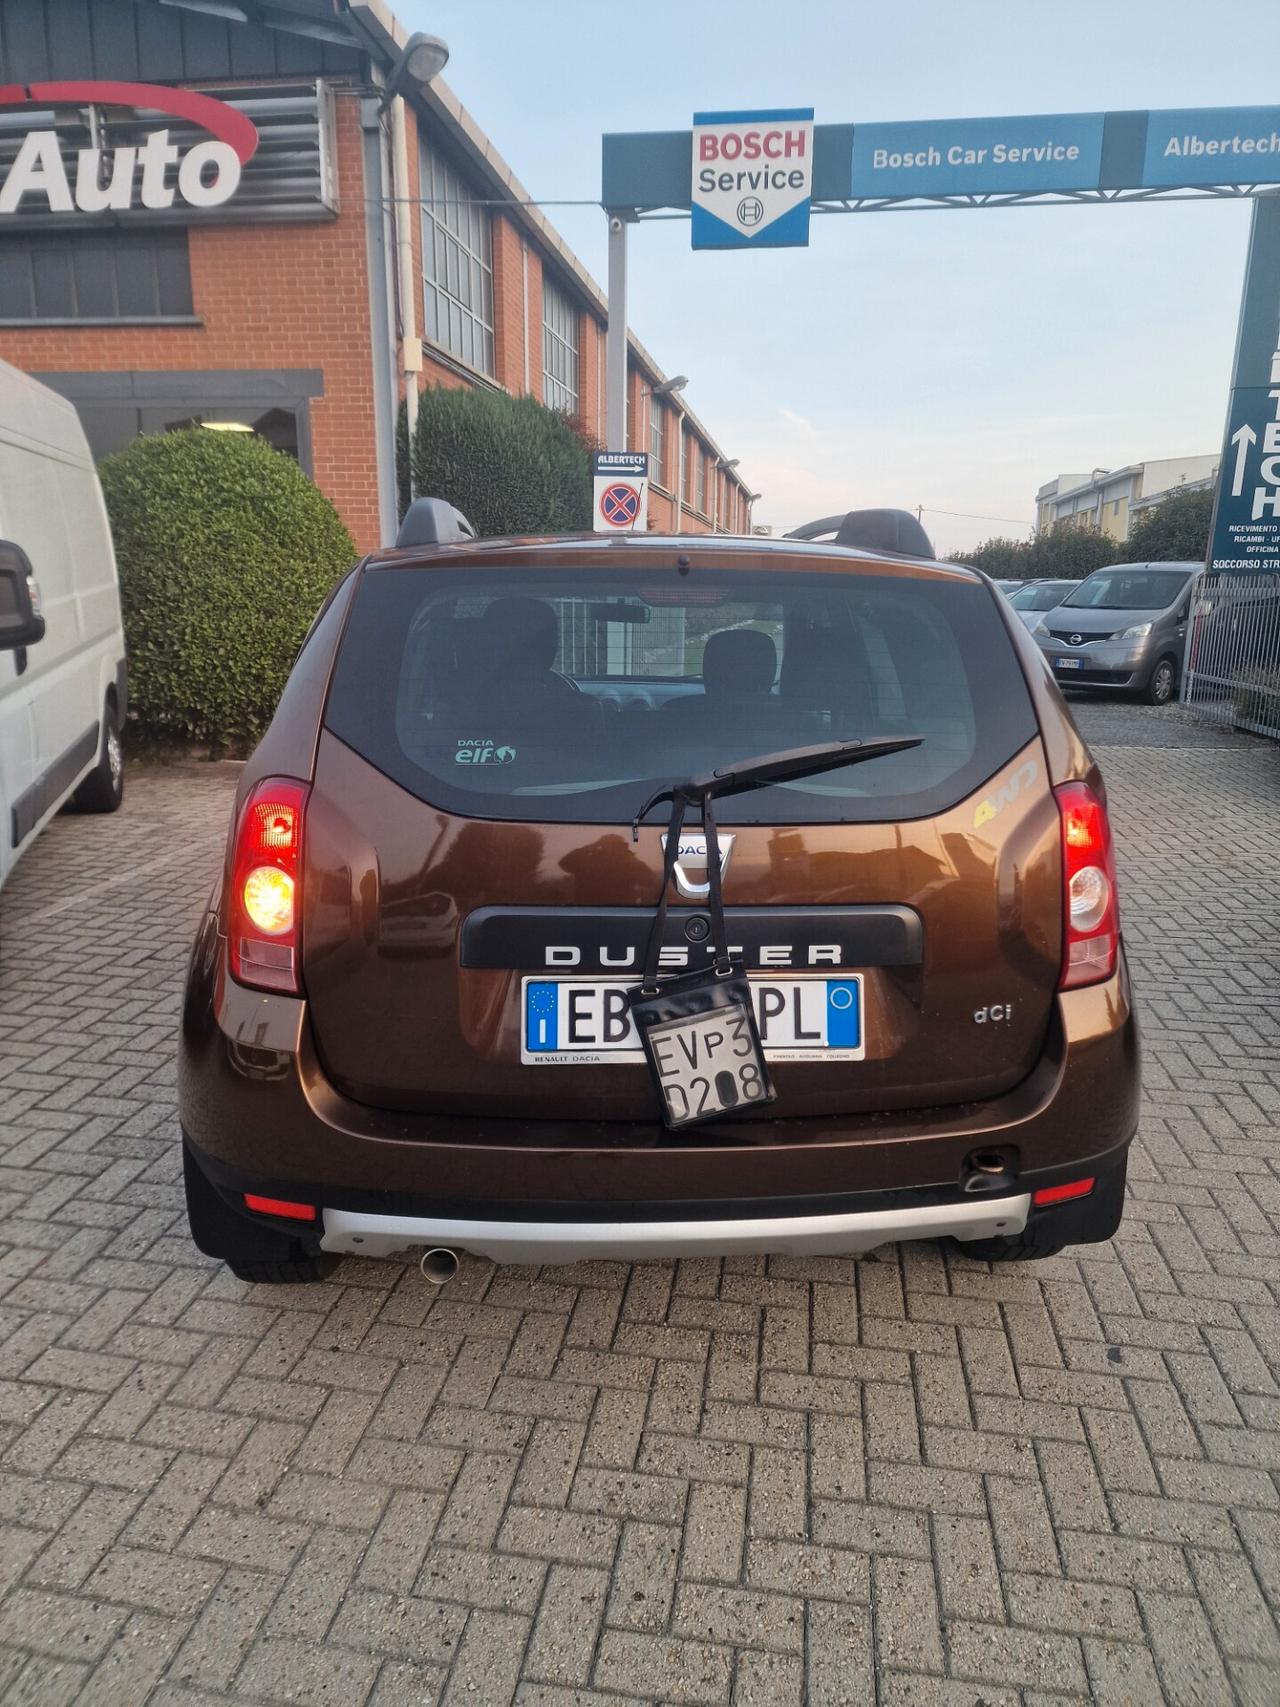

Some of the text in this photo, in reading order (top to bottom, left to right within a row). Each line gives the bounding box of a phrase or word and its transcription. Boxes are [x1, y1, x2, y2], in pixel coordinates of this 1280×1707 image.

[699, 130, 806, 161] BOSCH
[873, 141, 1080, 169] Bosch Car Service
[1164, 132, 1280, 157] Albertech
[0, 129, 242, 213] Auto
[699, 163, 805, 192] Service
[598, 455, 646, 464] ALBERTECH
[1212, 559, 1260, 569] SOCCORSO
[455, 747, 494, 763] elf
[973, 760, 1038, 829] 4WD
[974, 1004, 1012, 1024] dCi
